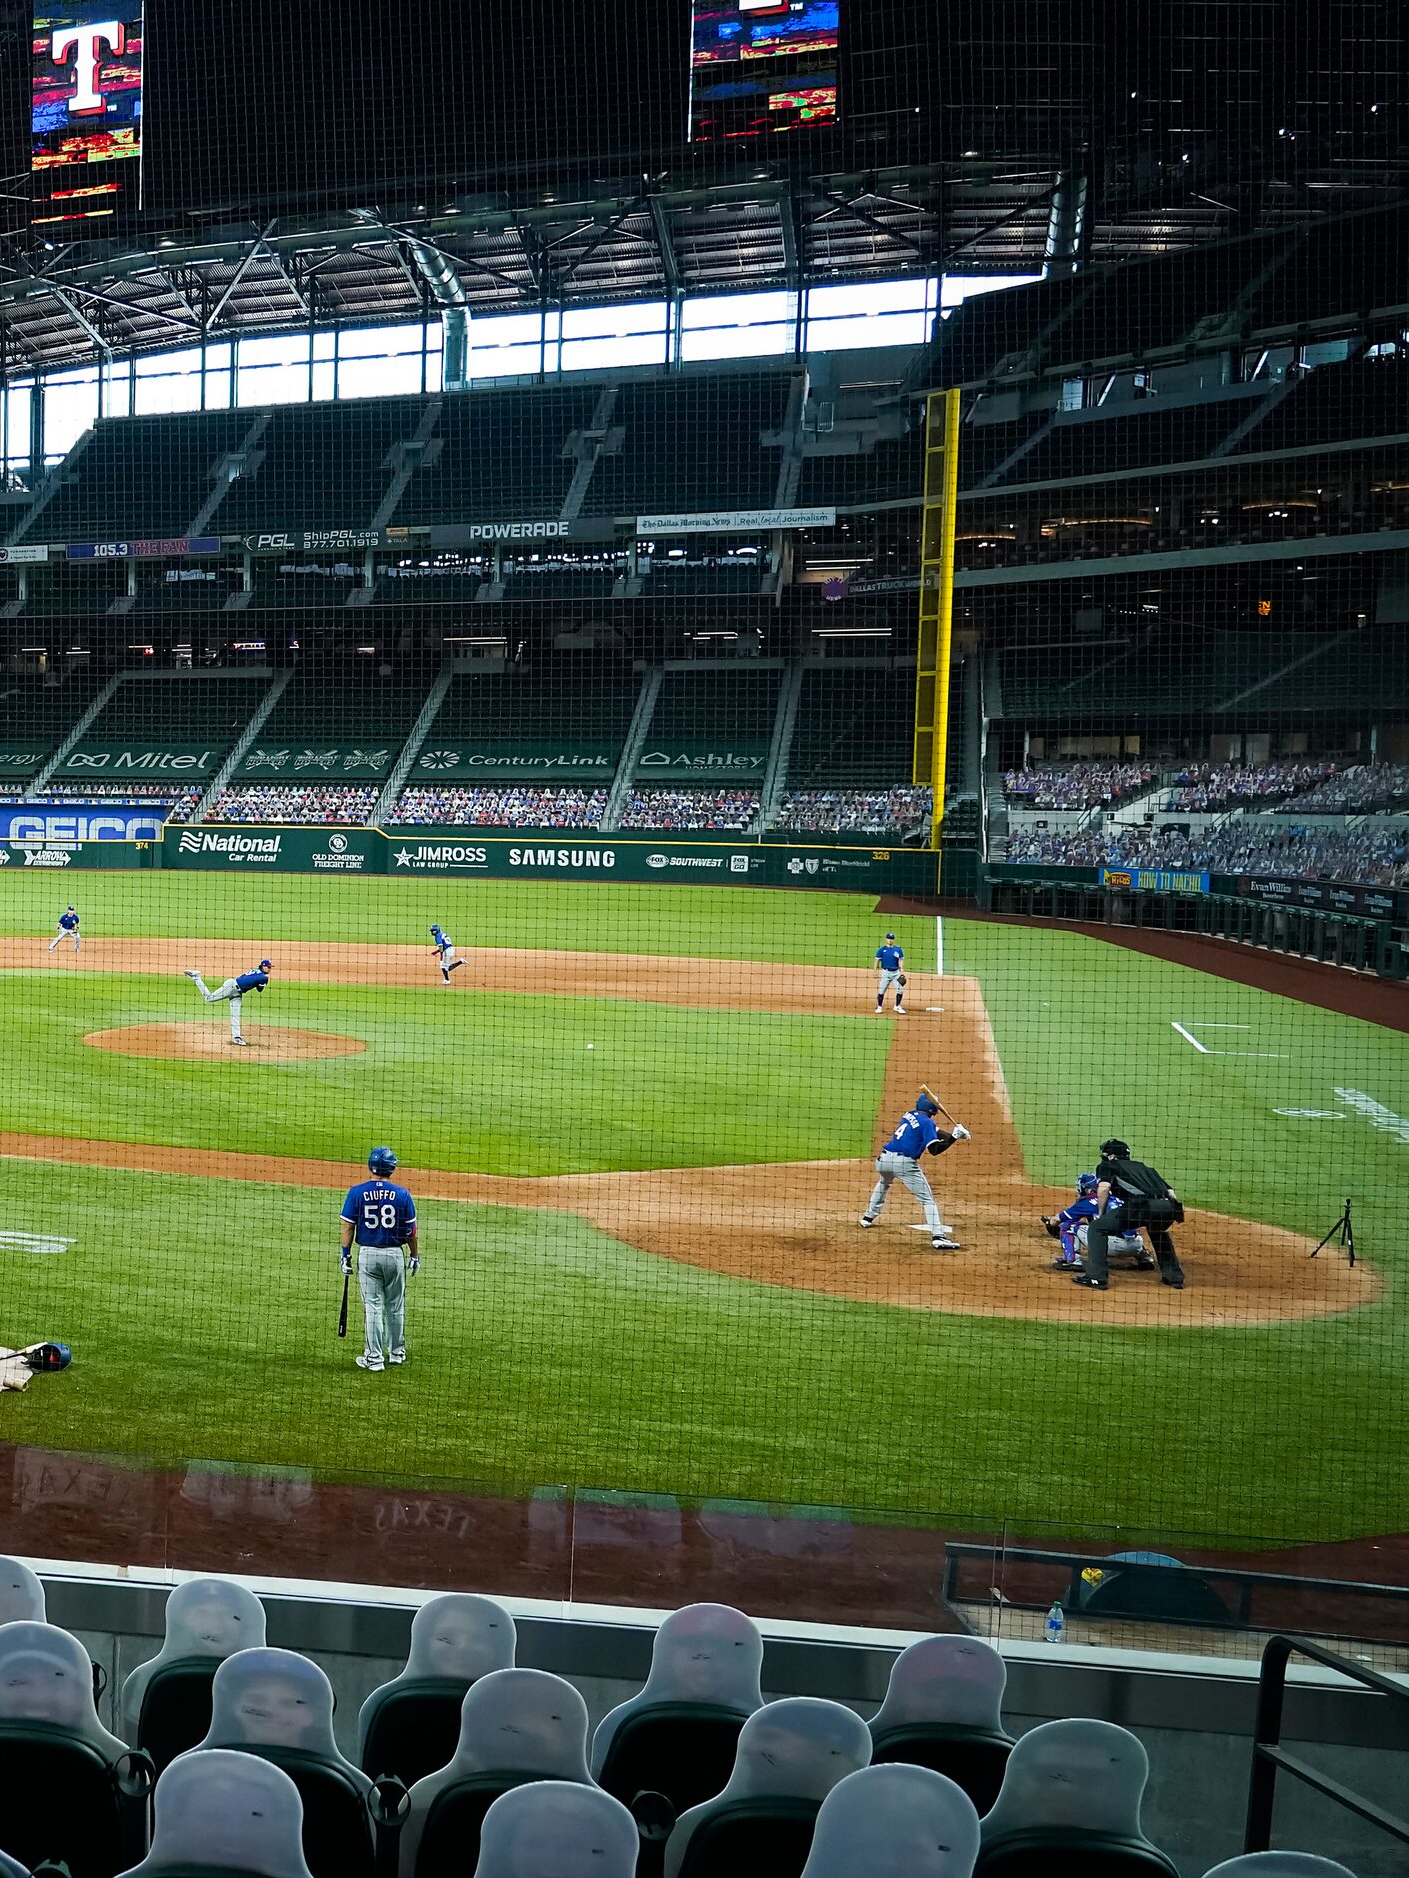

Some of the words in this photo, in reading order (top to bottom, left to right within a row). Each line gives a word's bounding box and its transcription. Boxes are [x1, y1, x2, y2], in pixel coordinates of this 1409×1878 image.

[642, 520, 656, 529] The
[657, 519, 679, 528] Dallas
[679, 518, 712, 528] Morning
[712, 517, 731, 526] News
[741, 517, 758, 525] Real
[782, 514, 828, 523] Journalism
[470, 521, 569, 539] POWERADE
[258, 534, 295, 548] PGL
[93, 544, 128, 557] 105.3
[129, 542, 158, 555] THE
[160, 540, 190, 554] FAN
[849, 584, 876, 592] DALLAS
[877, 581, 905, 590] TRUCK
[114, 752, 210, 769] Mitel
[469, 755, 609, 767] CenturyLink
[673, 753, 766, 768] Ashley
[10, 816, 163, 851] GEICO
[135, 842, 149, 850] 374
[36, 850, 65, 861] ARROW
[228, 853, 244, 862] Car
[246, 854, 276, 862] Rental
[328, 854, 364, 862] DOMINION
[509, 848, 615, 868] SAMSUNG
[872, 851, 890, 860] 326
[314, 860, 344, 868] FREIGHT
[345, 861, 362, 869] LINE
[670, 857, 723, 868] SOUTHWEST
[1138, 871, 1157, 889] HOW
[1160, 872, 1170, 890] TO
[1172, 873, 1202, 892] NACHO
[363, 1190, 396, 1201] CIUFFO
[364, 1204, 396, 1229] 58
